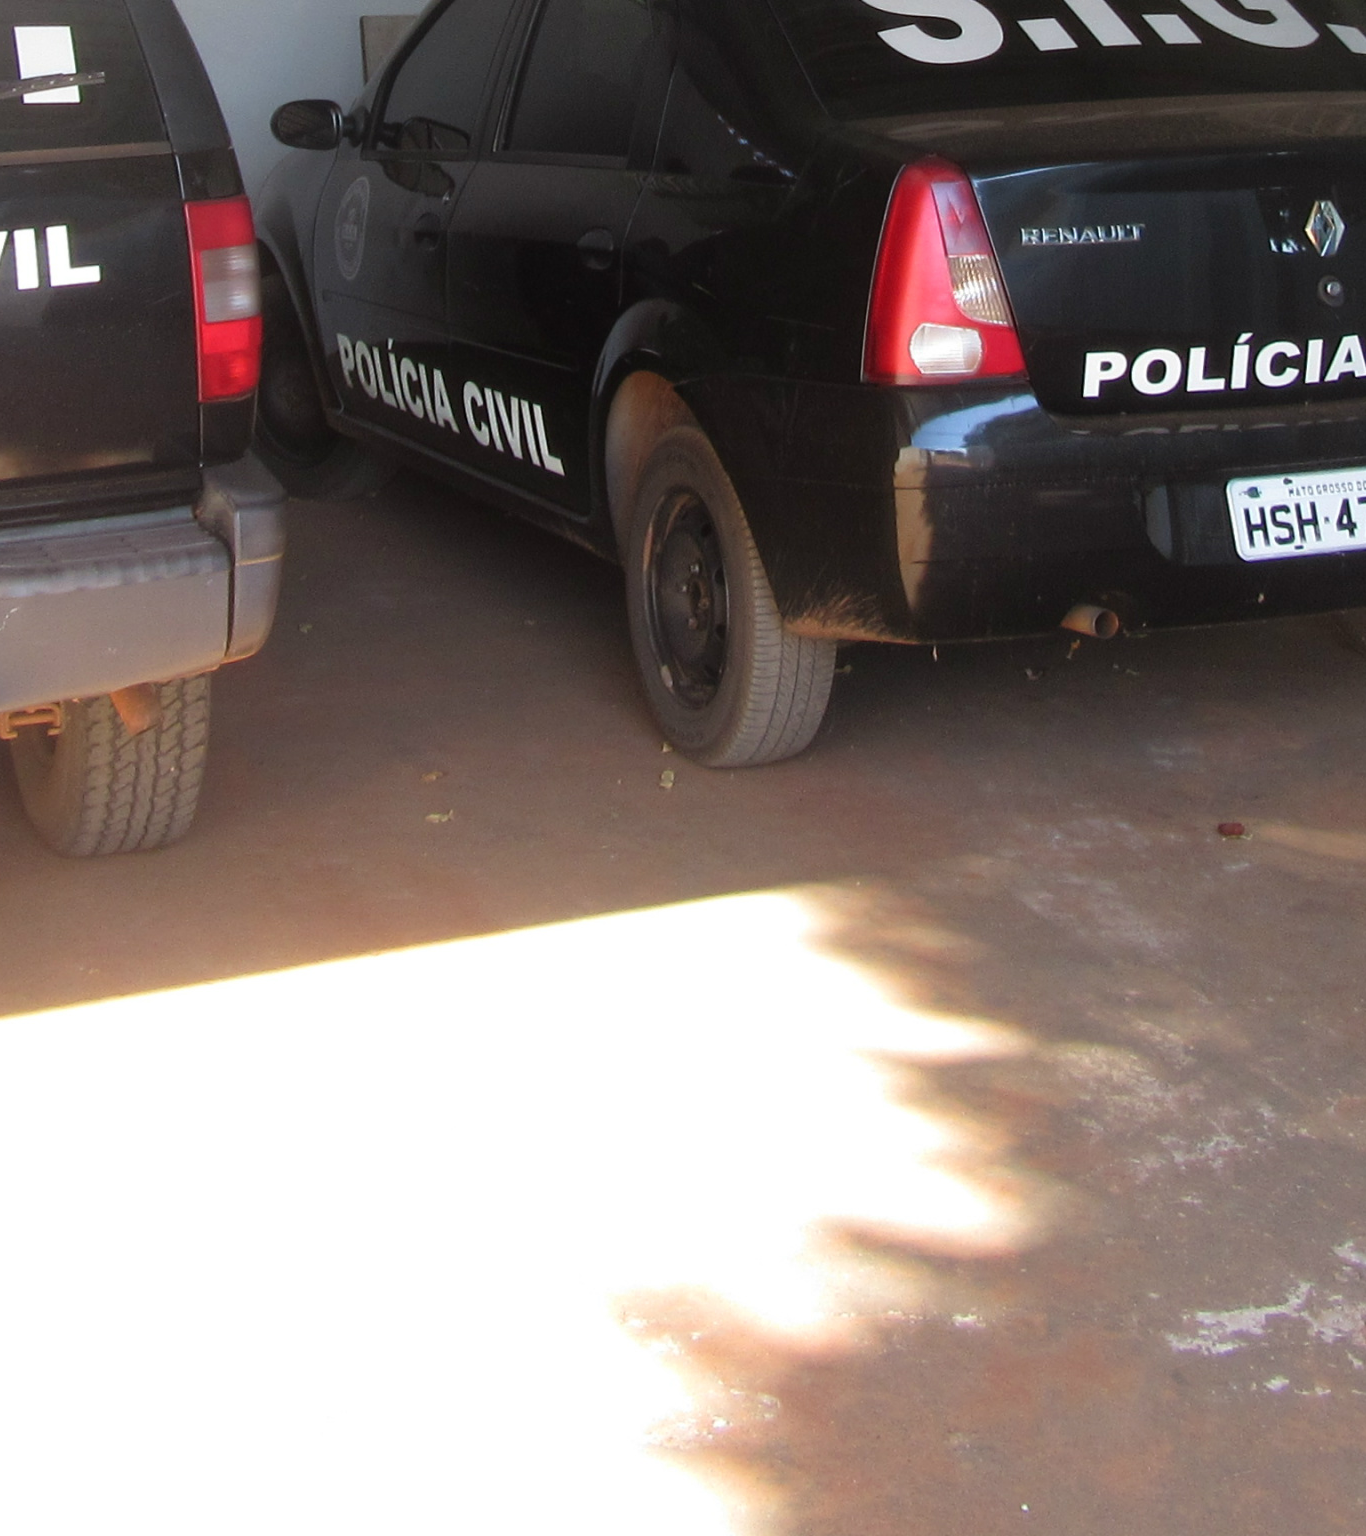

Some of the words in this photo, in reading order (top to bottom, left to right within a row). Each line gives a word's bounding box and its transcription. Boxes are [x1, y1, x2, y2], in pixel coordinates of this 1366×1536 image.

[1020, 224, 1146, 245] RENAULT
[337, 333, 460, 434] POLÍCIA
[463, 381, 565, 476] CIVIL
[1288, 486, 1315, 498] MATO
[1316, 482, 1354, 495] GROSSO
